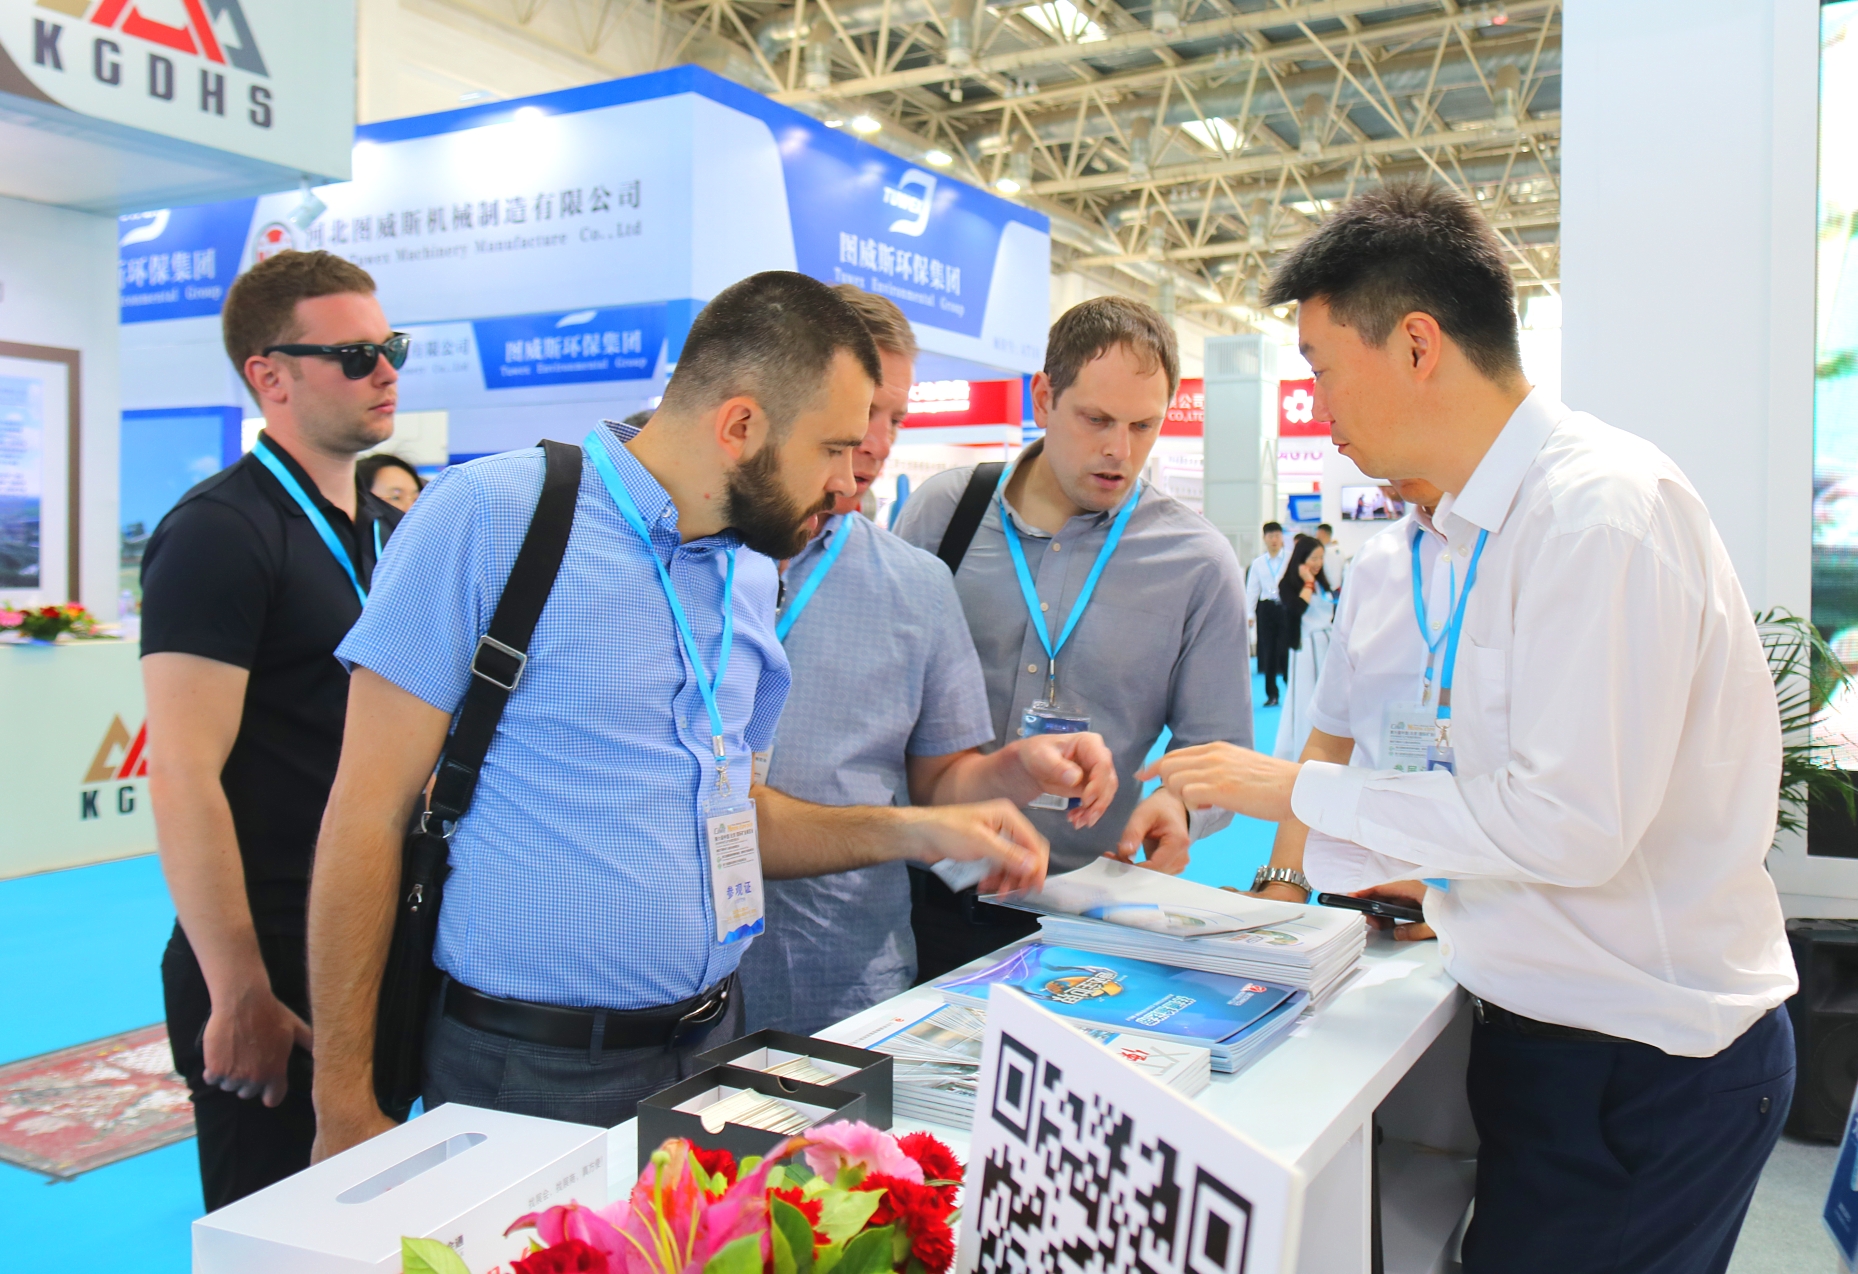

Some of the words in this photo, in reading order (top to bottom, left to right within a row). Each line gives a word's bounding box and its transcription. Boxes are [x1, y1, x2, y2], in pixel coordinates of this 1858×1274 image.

[33, 17, 273, 130] KGDHS
[838, 231, 961, 296] 图威斯环保集团
[504, 329, 643, 364] 图威斯环保集团
[726, 881, 752, 899] 参观证
